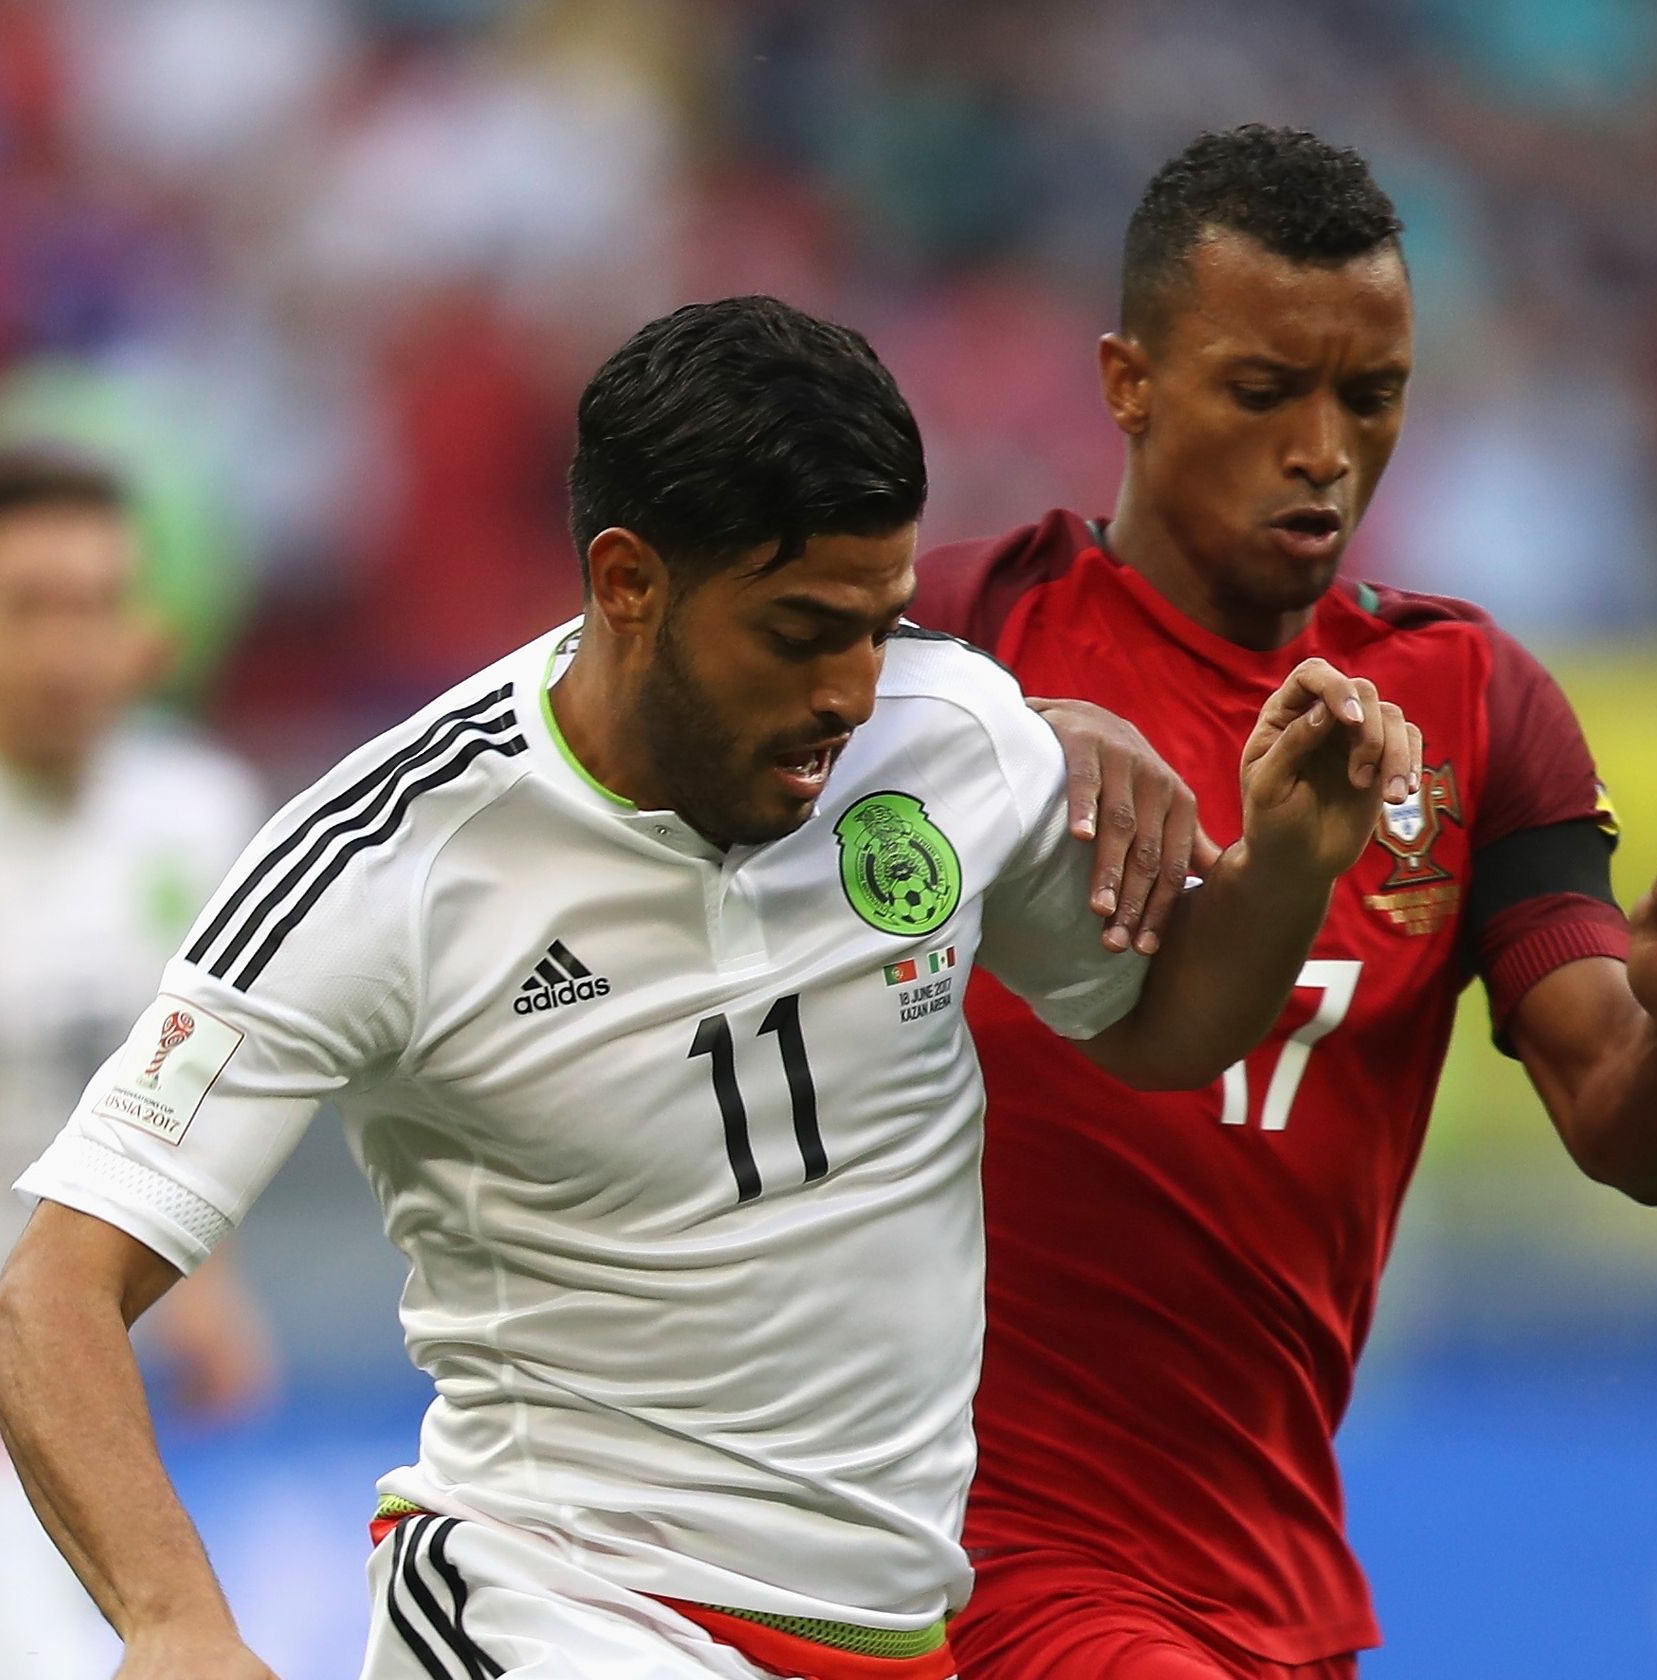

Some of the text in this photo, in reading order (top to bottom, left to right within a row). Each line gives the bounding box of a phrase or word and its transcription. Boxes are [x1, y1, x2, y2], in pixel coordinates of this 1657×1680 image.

[513, 978, 611, 1015] adidas
[687, 992, 829, 1204] 11
[142, 1107, 181, 1133] 2017
